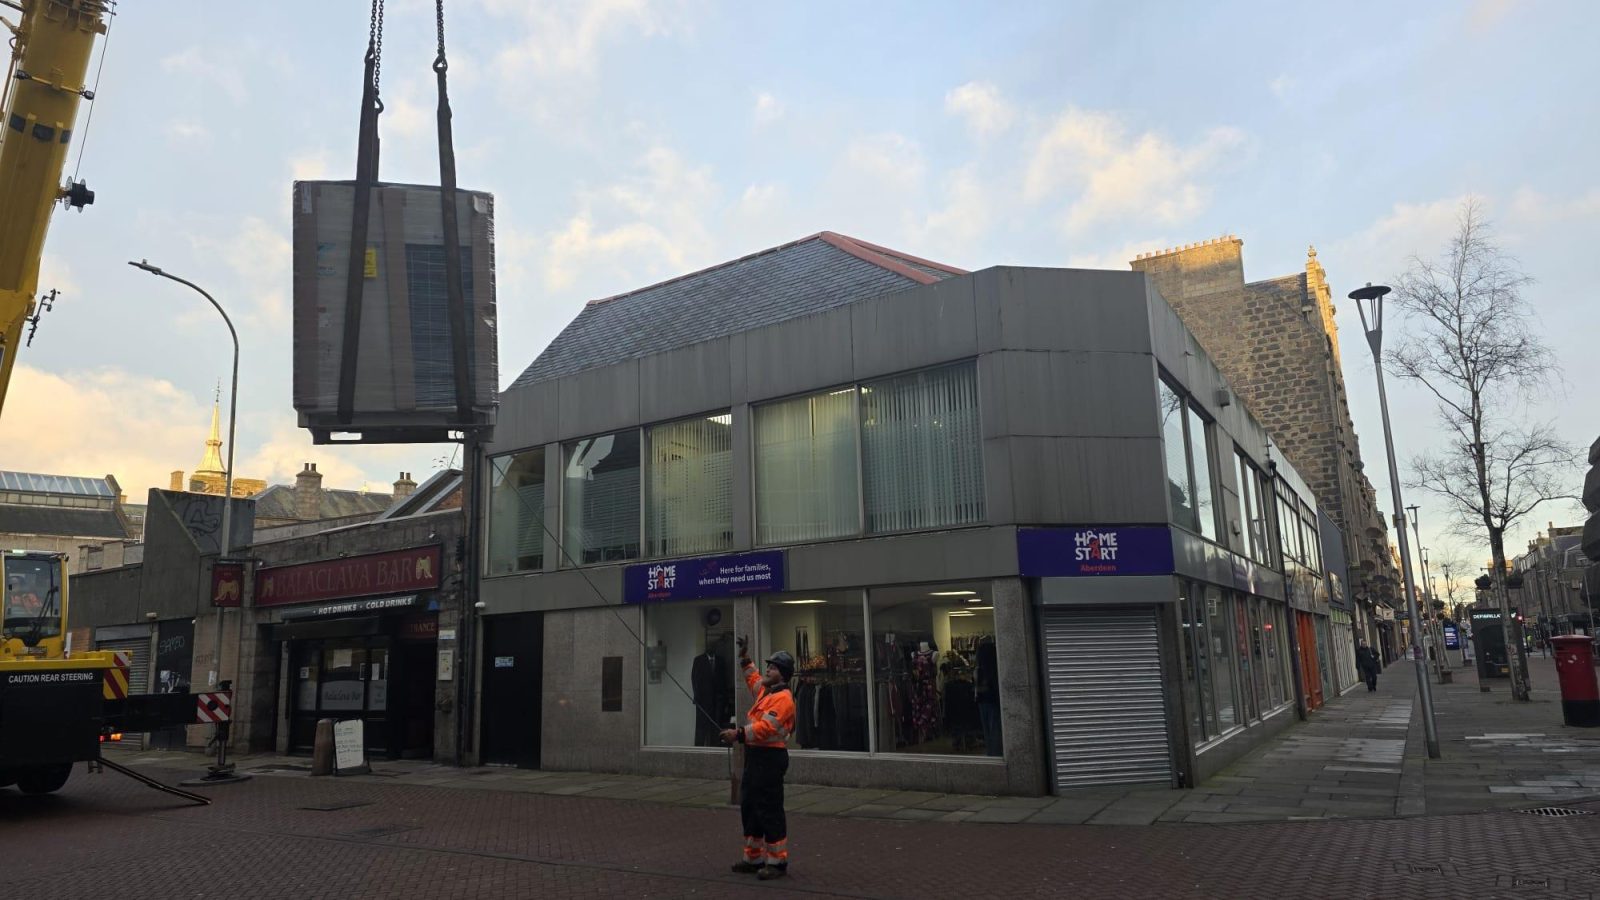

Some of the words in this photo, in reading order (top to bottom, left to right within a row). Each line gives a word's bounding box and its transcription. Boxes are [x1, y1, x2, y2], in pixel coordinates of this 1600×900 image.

[1074, 530, 1118, 547] HOME
[1075, 546, 1118, 561] START
[648, 564, 676, 579] HOME
[719, 566, 735, 575] Here
[734, 565, 744, 573] for
[744, 563, 771, 572] families,
[1080, 563, 1117, 572] Aberdeen
[273, 563, 371, 597] BALACLAVA
[376, 558, 413, 585] BAR
[647, 577, 676, 590] START
[698, 577, 715, 586] when
[715, 576, 730, 585] they
[730, 574, 746, 582] need
[754, 573, 771, 581] most
[332, 604, 357, 614] DRINKS
[366, 601, 384, 610] COLD
[385, 597, 412, 607] DRINKS
[8, 674, 40, 684] CAUTION
[40, 673, 60, 682] REAR
[61, 672, 94, 681] STEERING
